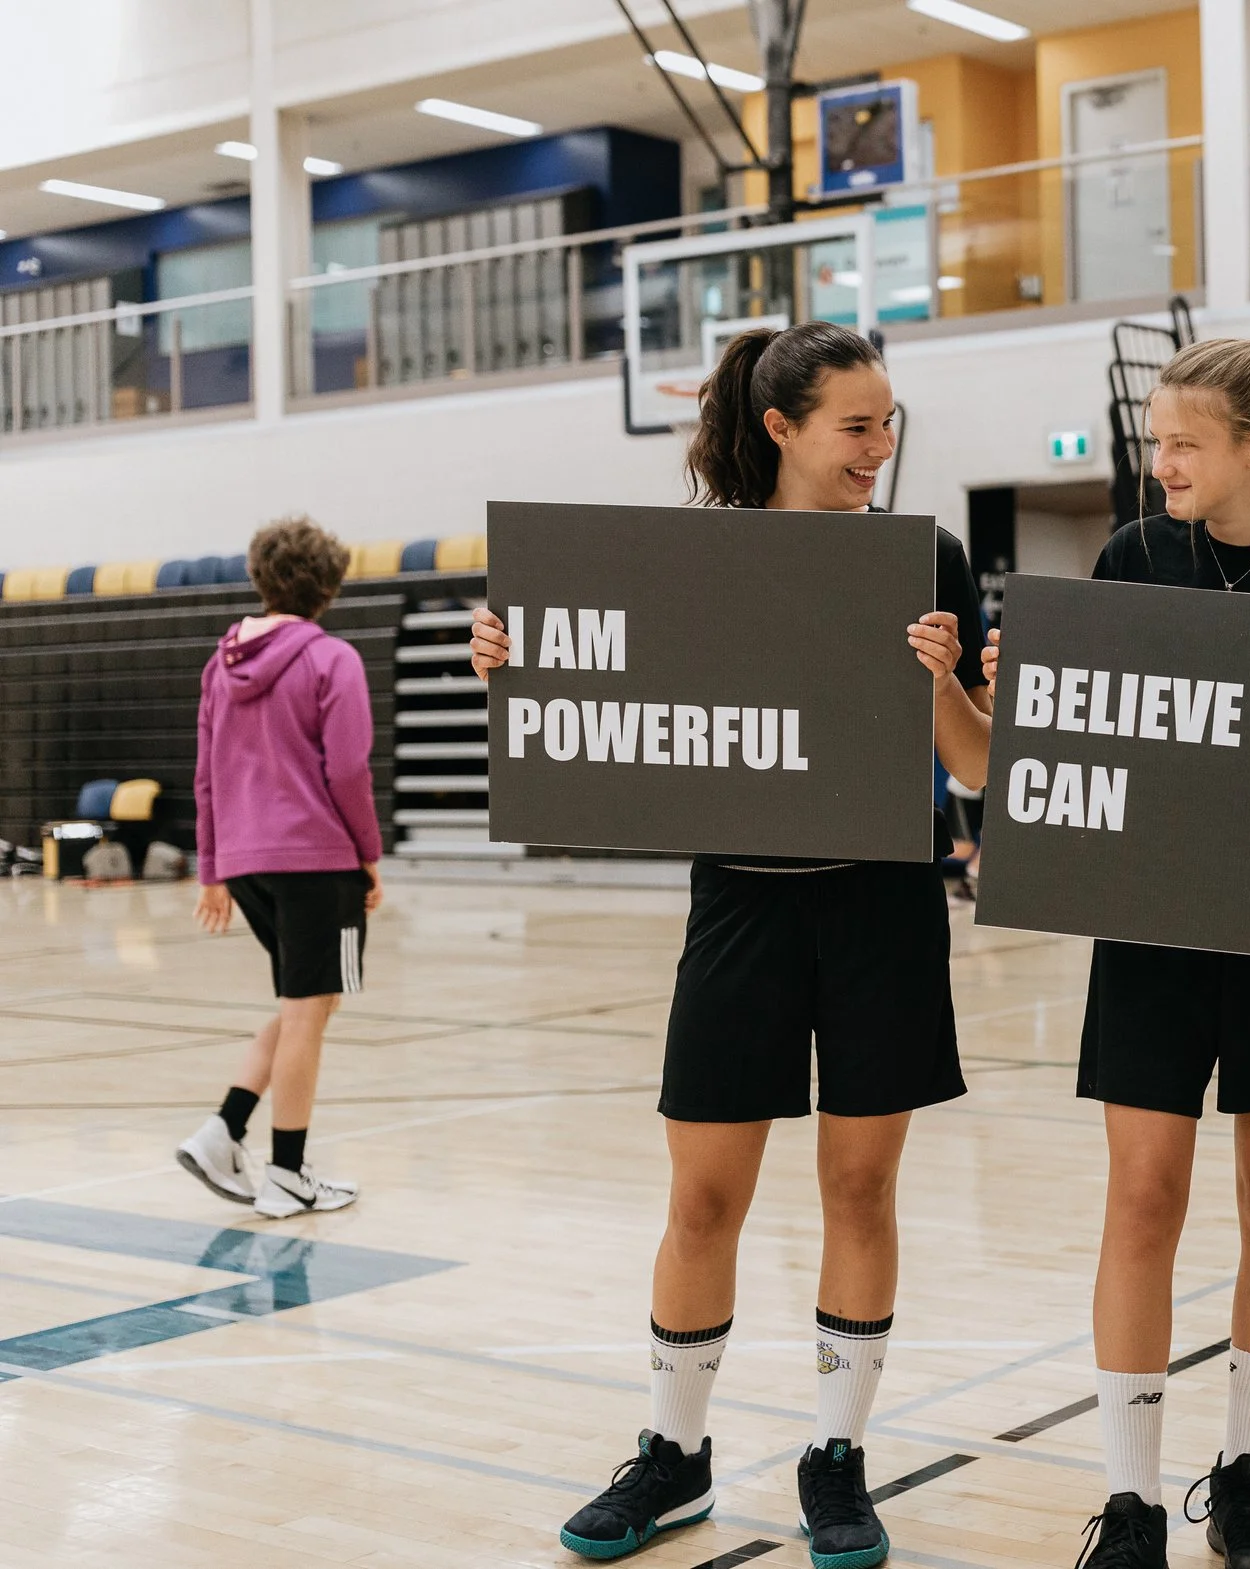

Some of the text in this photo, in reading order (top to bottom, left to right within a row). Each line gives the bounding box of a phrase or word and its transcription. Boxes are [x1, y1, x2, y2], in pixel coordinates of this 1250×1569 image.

[507, 606, 626, 672] I AM
[508, 697, 809, 771] POWERFUL
[1014, 663, 1245, 748] BELIEVE
[1007, 757, 1129, 832] CAN
